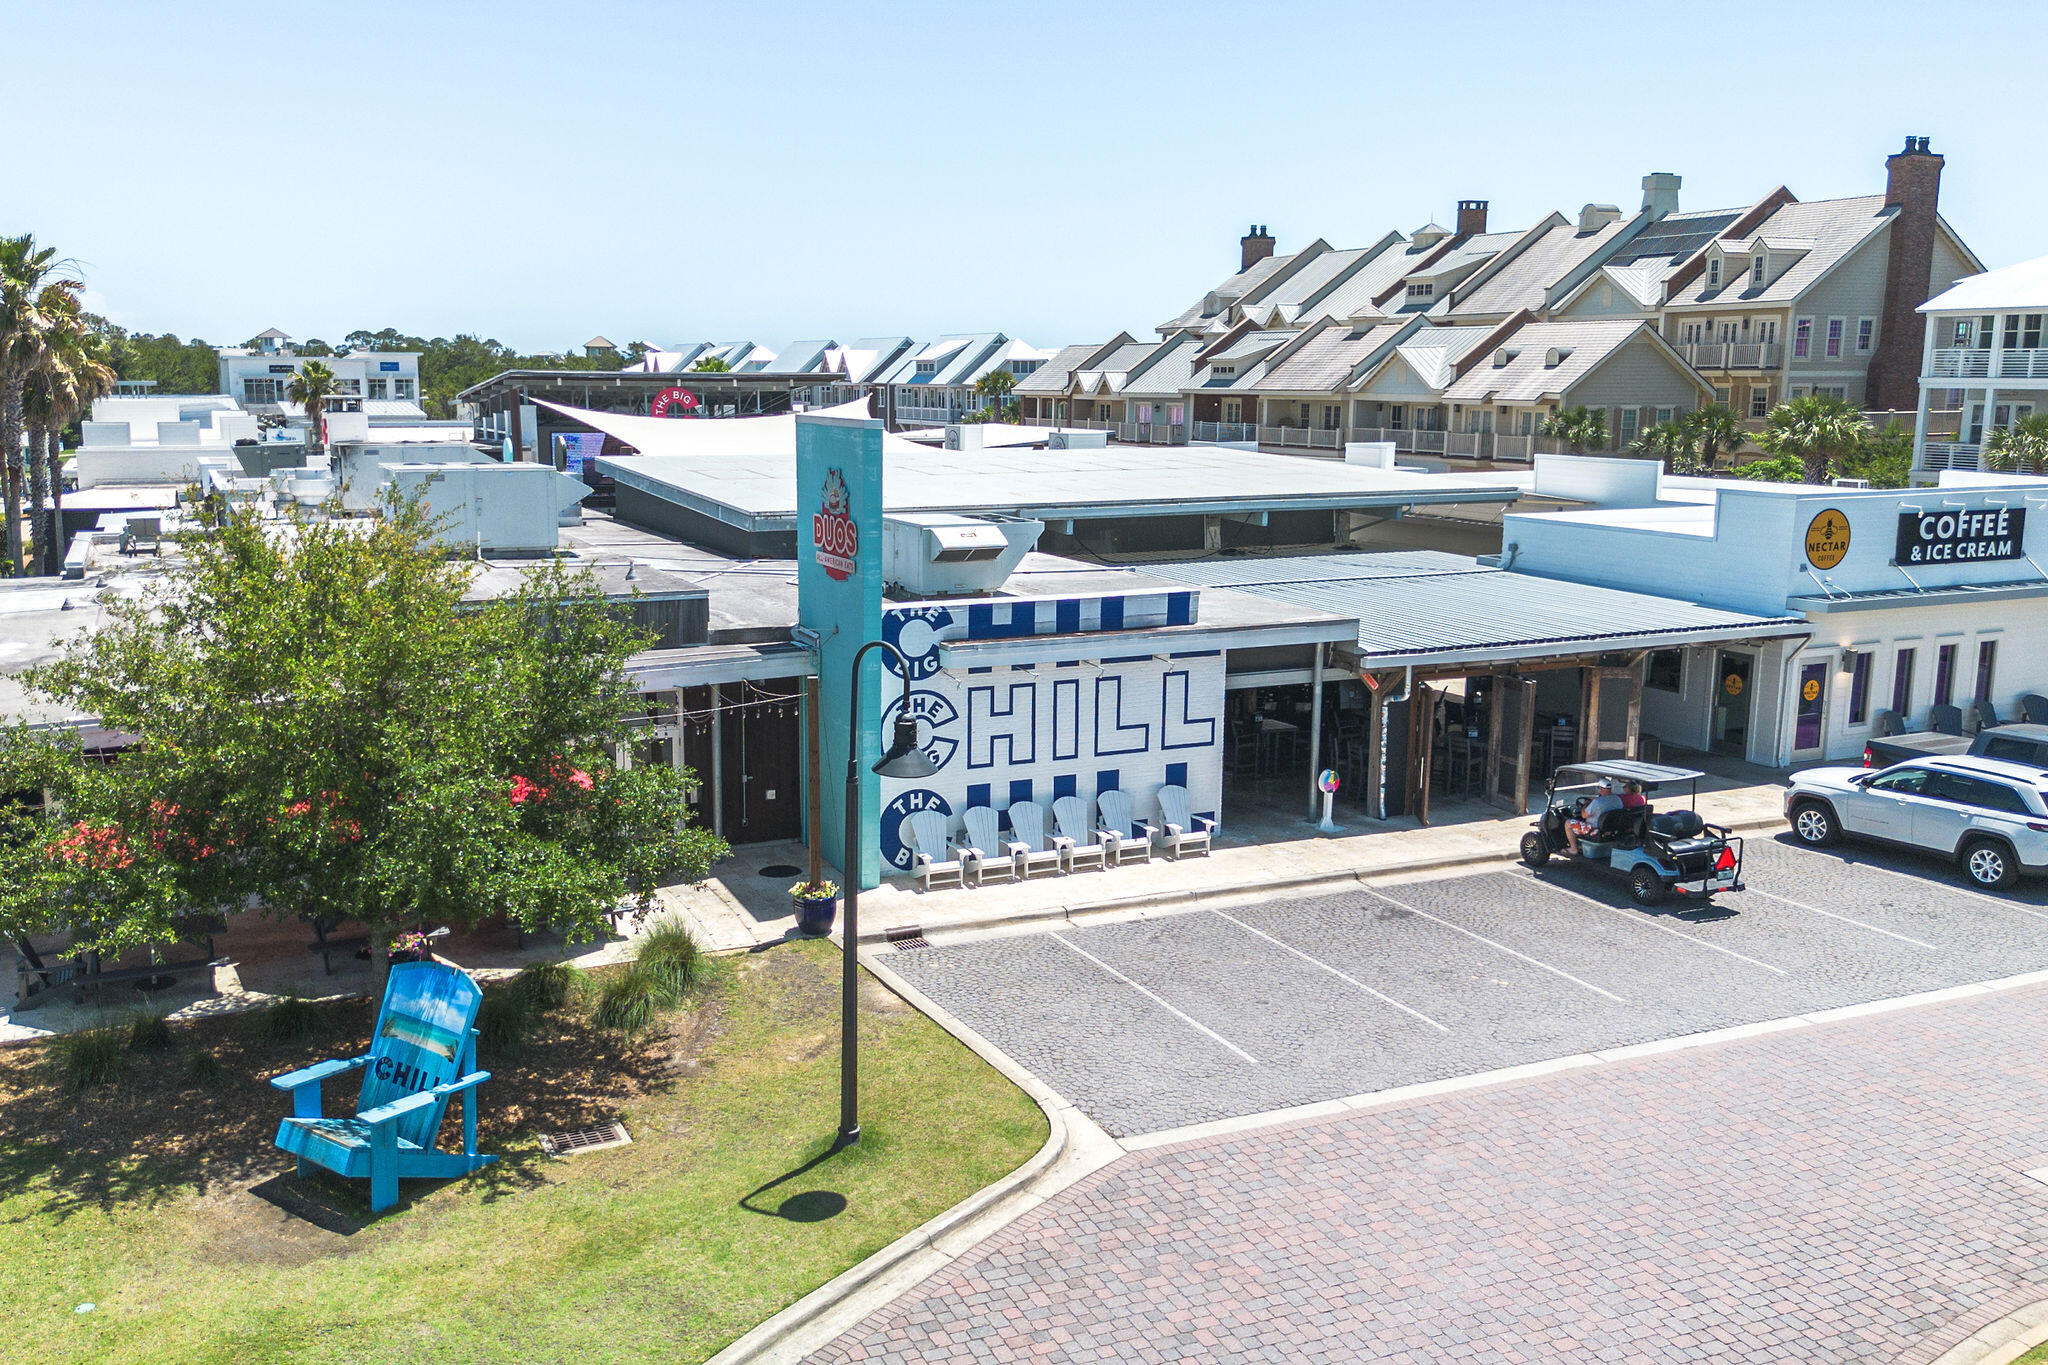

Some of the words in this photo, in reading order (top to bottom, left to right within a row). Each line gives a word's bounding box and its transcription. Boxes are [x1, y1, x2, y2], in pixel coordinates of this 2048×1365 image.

[656, 394, 669, 414] THE
[673, 391, 691, 404] BIG
[813, 513, 857, 556] DUOS
[1920, 513, 2009, 540] COFFEE
[1808, 541, 1846, 552] NECTAR
[1817, 554, 1835, 562] COFFEE
[1910, 545, 1922, 561] &
[1926, 543, 1952, 560] ICE
[1956, 540, 2011, 558] CREAM
[892, 792, 941, 815] THE
